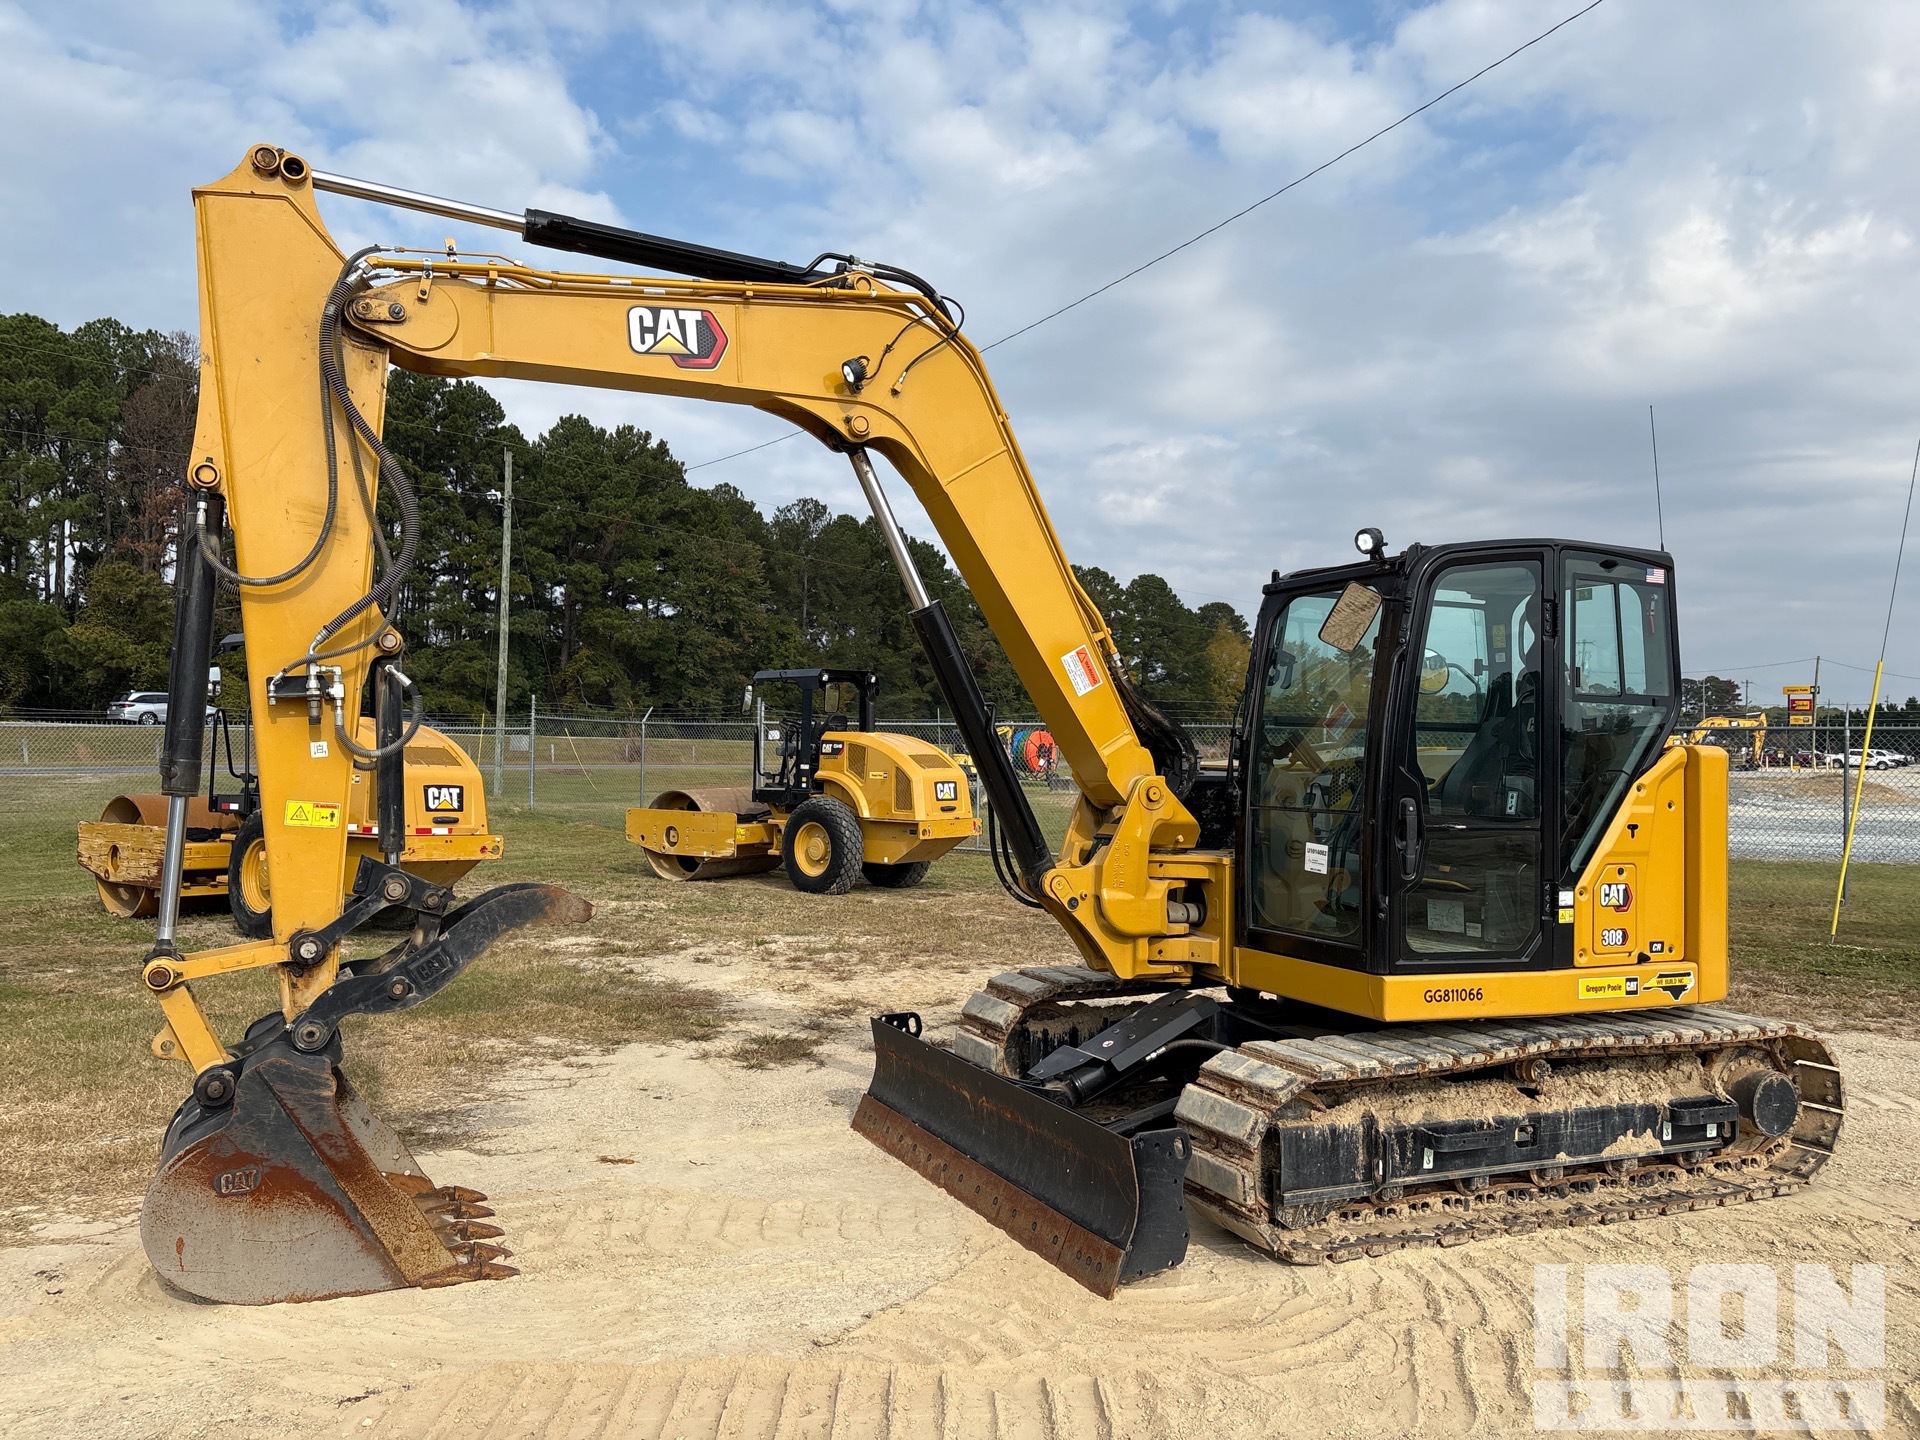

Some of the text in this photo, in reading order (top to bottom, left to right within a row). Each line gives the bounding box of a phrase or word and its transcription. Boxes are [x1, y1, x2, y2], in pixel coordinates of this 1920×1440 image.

[629, 307, 702, 354] CAT
[822, 743, 832, 753] CAT
[428, 787, 460, 809] CAT
[936, 783, 955, 800] CAT
[1601, 884, 1626, 906] CAT
[1602, 930, 1623, 945] 308
[1652, 943, 1662, 951] CR
[1586, 981, 1637, 993] Gregory Poole CAT
[1424, 988, 1483, 1003] GG811066
[220, 1169, 257, 1194] CAT
